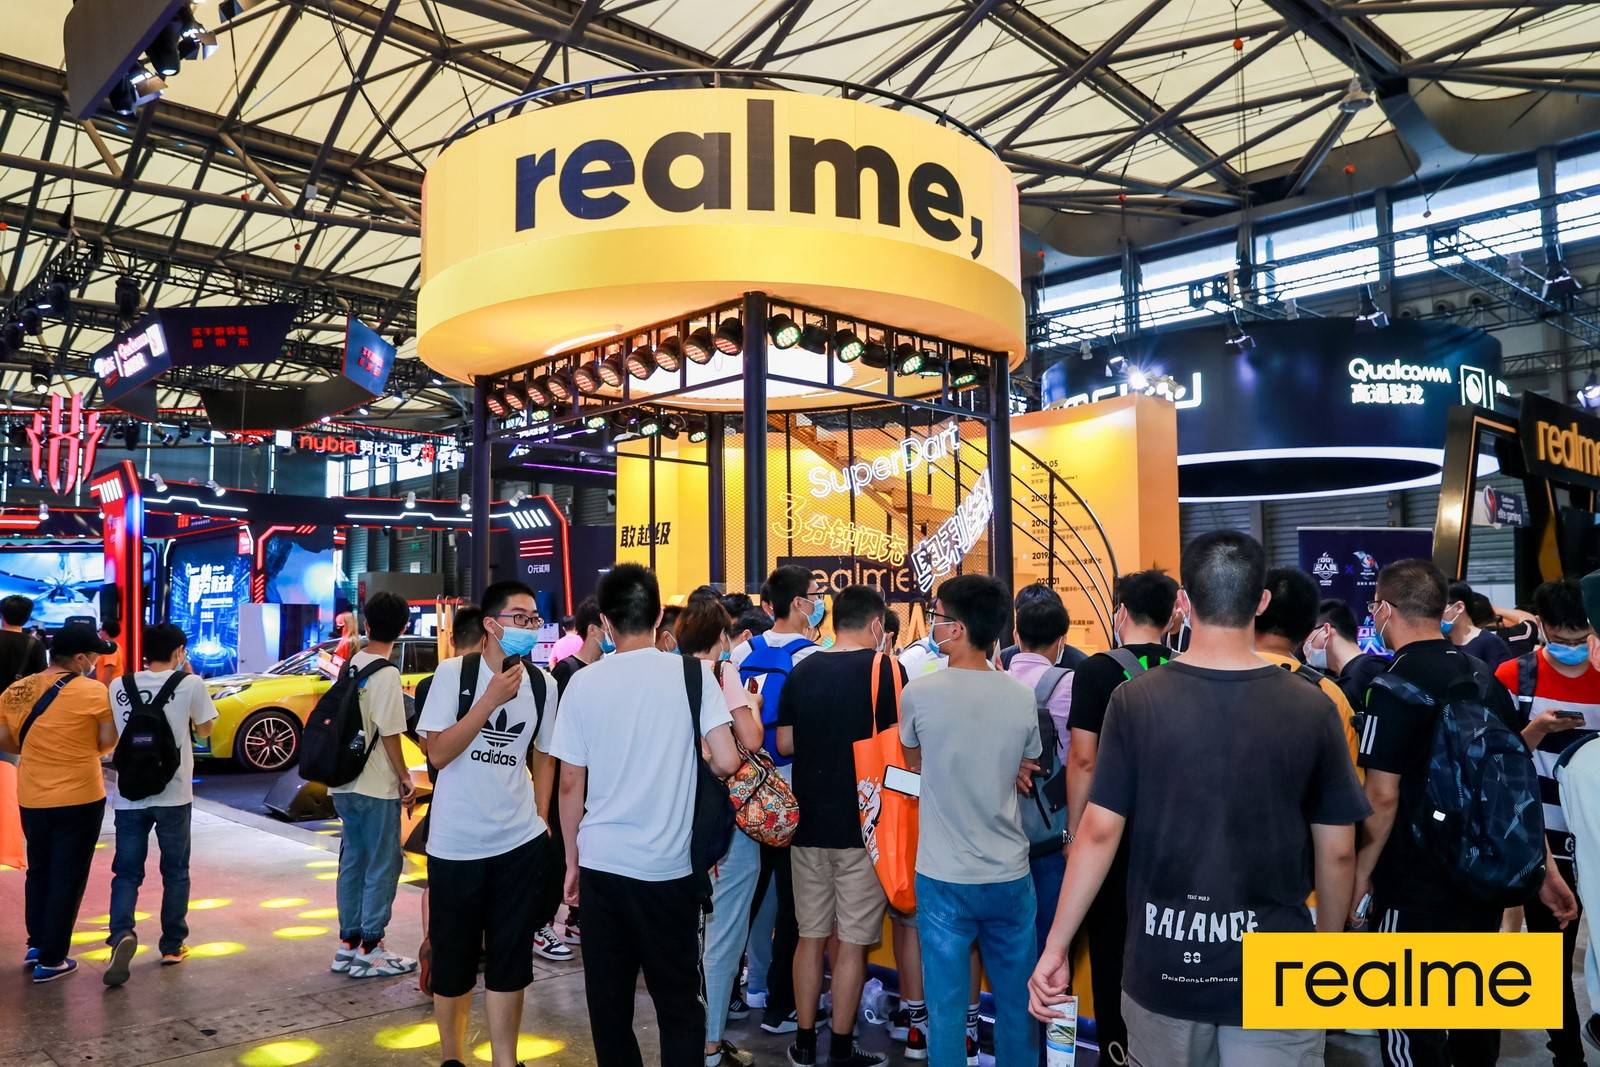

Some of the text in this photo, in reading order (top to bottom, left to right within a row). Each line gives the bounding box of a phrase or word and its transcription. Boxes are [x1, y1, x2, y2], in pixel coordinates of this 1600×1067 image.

[1348, 357, 1452, 384] Qualcomm
[1350, 382, 1425, 405] 高通骁龙
[300, 434, 357, 454] nubia
[359, 439, 404, 459] 努比亚
[809, 420, 961, 498] SuperDart
[620, 521, 671, 548] 敢越级
[771, 492, 907, 567] 3分钟闪充
[810, 563, 911, 593] ealme
[470, 749, 517, 767] adidas
[1145, 901, 1259, 943] BALANCE
